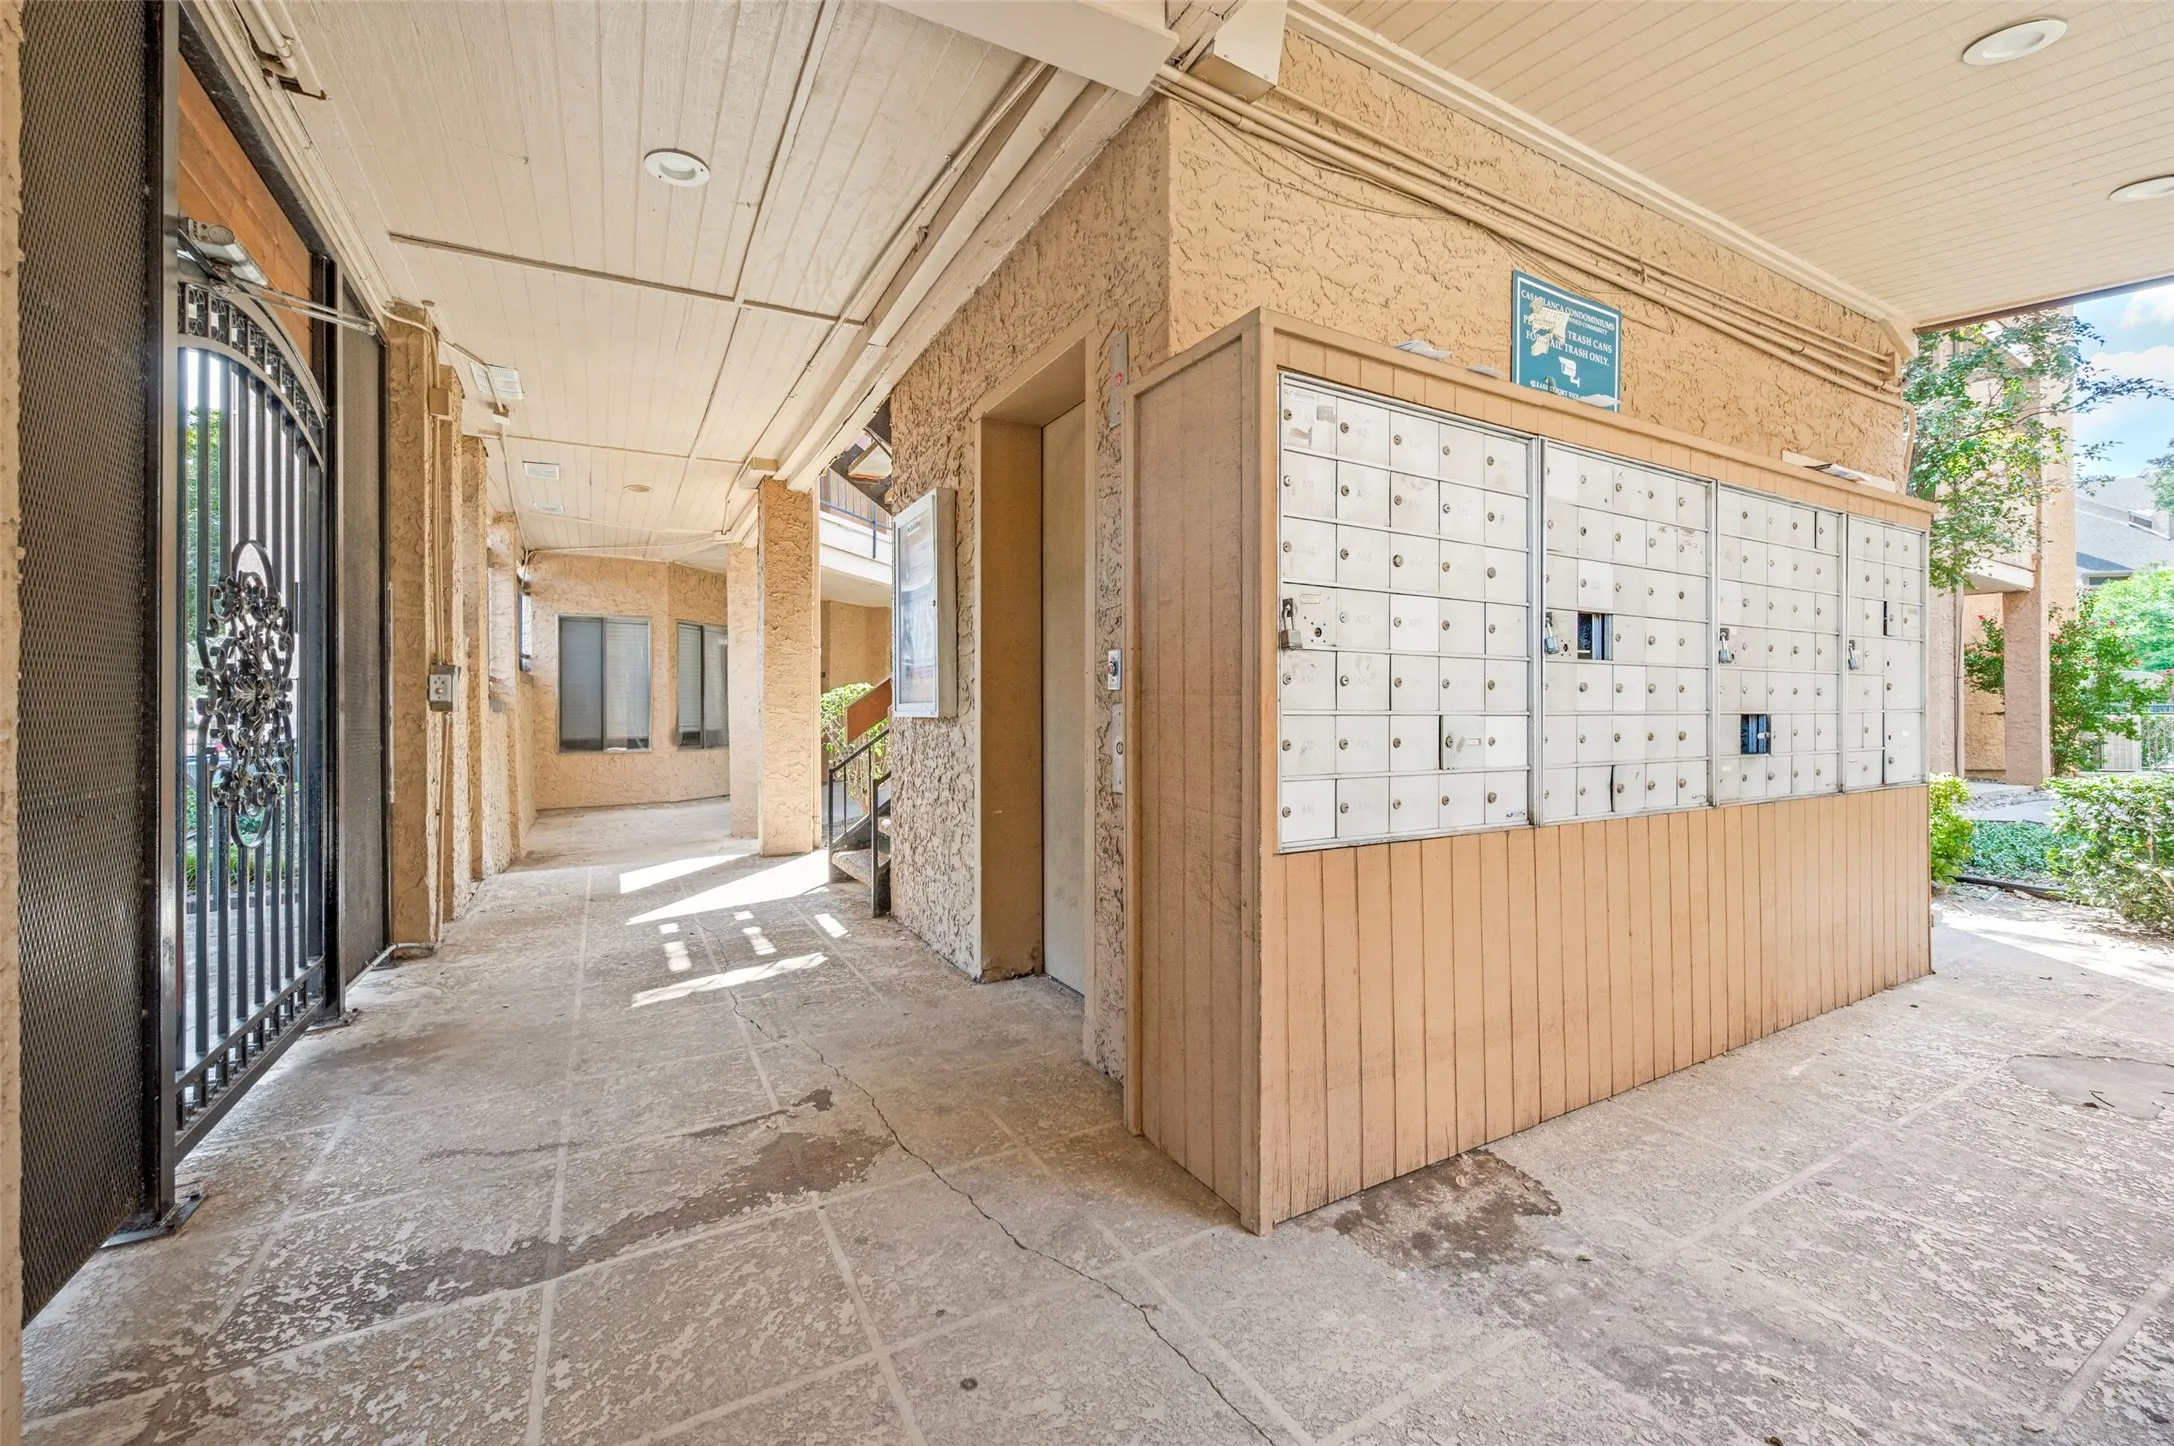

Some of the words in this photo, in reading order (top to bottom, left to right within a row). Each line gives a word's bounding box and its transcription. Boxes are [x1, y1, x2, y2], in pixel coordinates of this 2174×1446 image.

[1521, 289, 1564, 312] CASALANCA
[1565, 307, 1615, 331] CONDOMINIUMS
[1567, 330, 1592, 347] TRASH
[1593, 340, 1612, 354] CANS
[1582, 322, 1608, 336] COMMUNITY
[1547, 338, 1563, 351] AIL
[1564, 343, 1588, 359] TRASH
[1589, 352, 1610, 367] ONLY.
